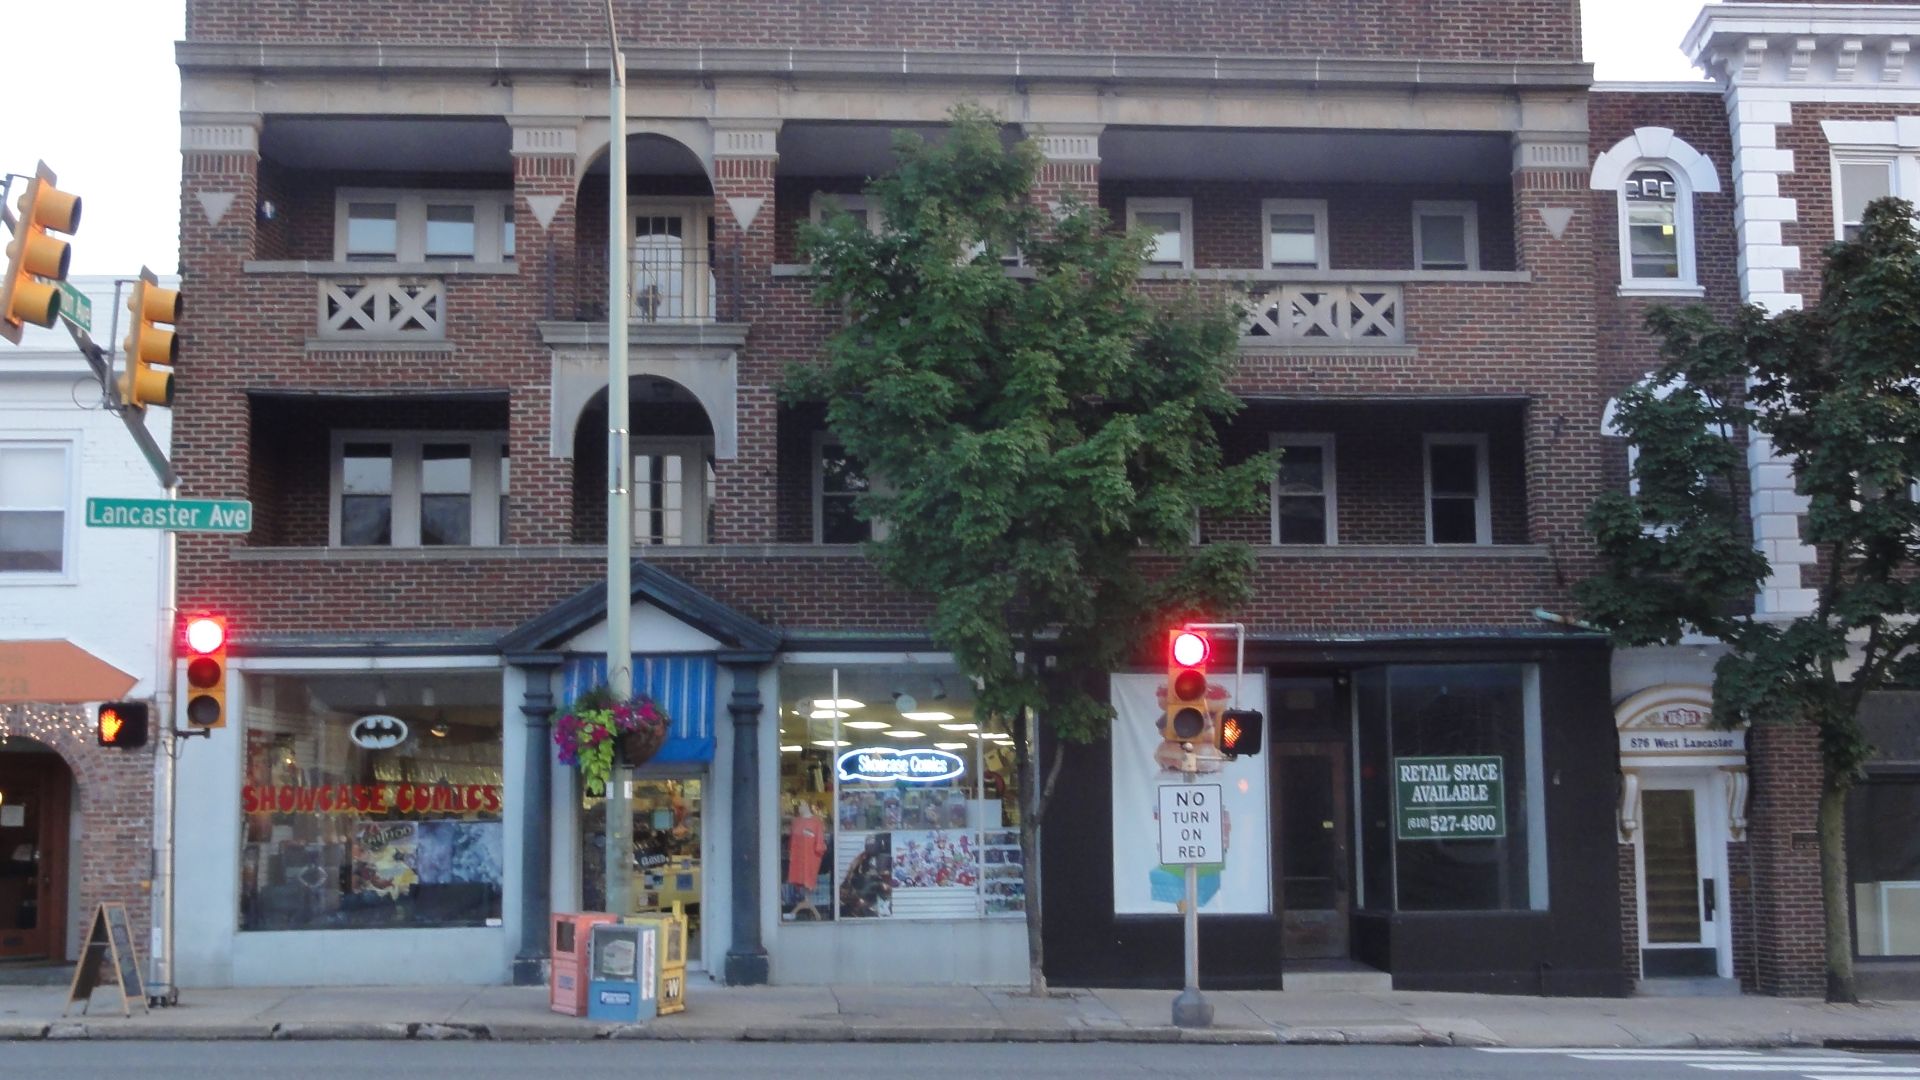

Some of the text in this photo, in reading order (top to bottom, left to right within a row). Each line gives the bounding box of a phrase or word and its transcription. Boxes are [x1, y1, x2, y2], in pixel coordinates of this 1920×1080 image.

[89, 501, 247, 528] Lancaster Ave
[1654, 738, 1679, 749] West
[1684, 737, 1734, 749] Lancaster
[858, 754, 948, 773] Showcase Comics
[1400, 763, 1498, 782] RETAIL SPACE
[241, 783, 502, 814] SHOWCASE COMICS
[1176, 791, 1205, 806] NO
[1412, 784, 1489, 802] AVAILABLE
[1172, 811, 1209, 824] TURN
[1407, 814, 1496, 832] (610) 527-4800
[1181, 828, 1202, 841] ON
[1179, 846, 1206, 858] RED
